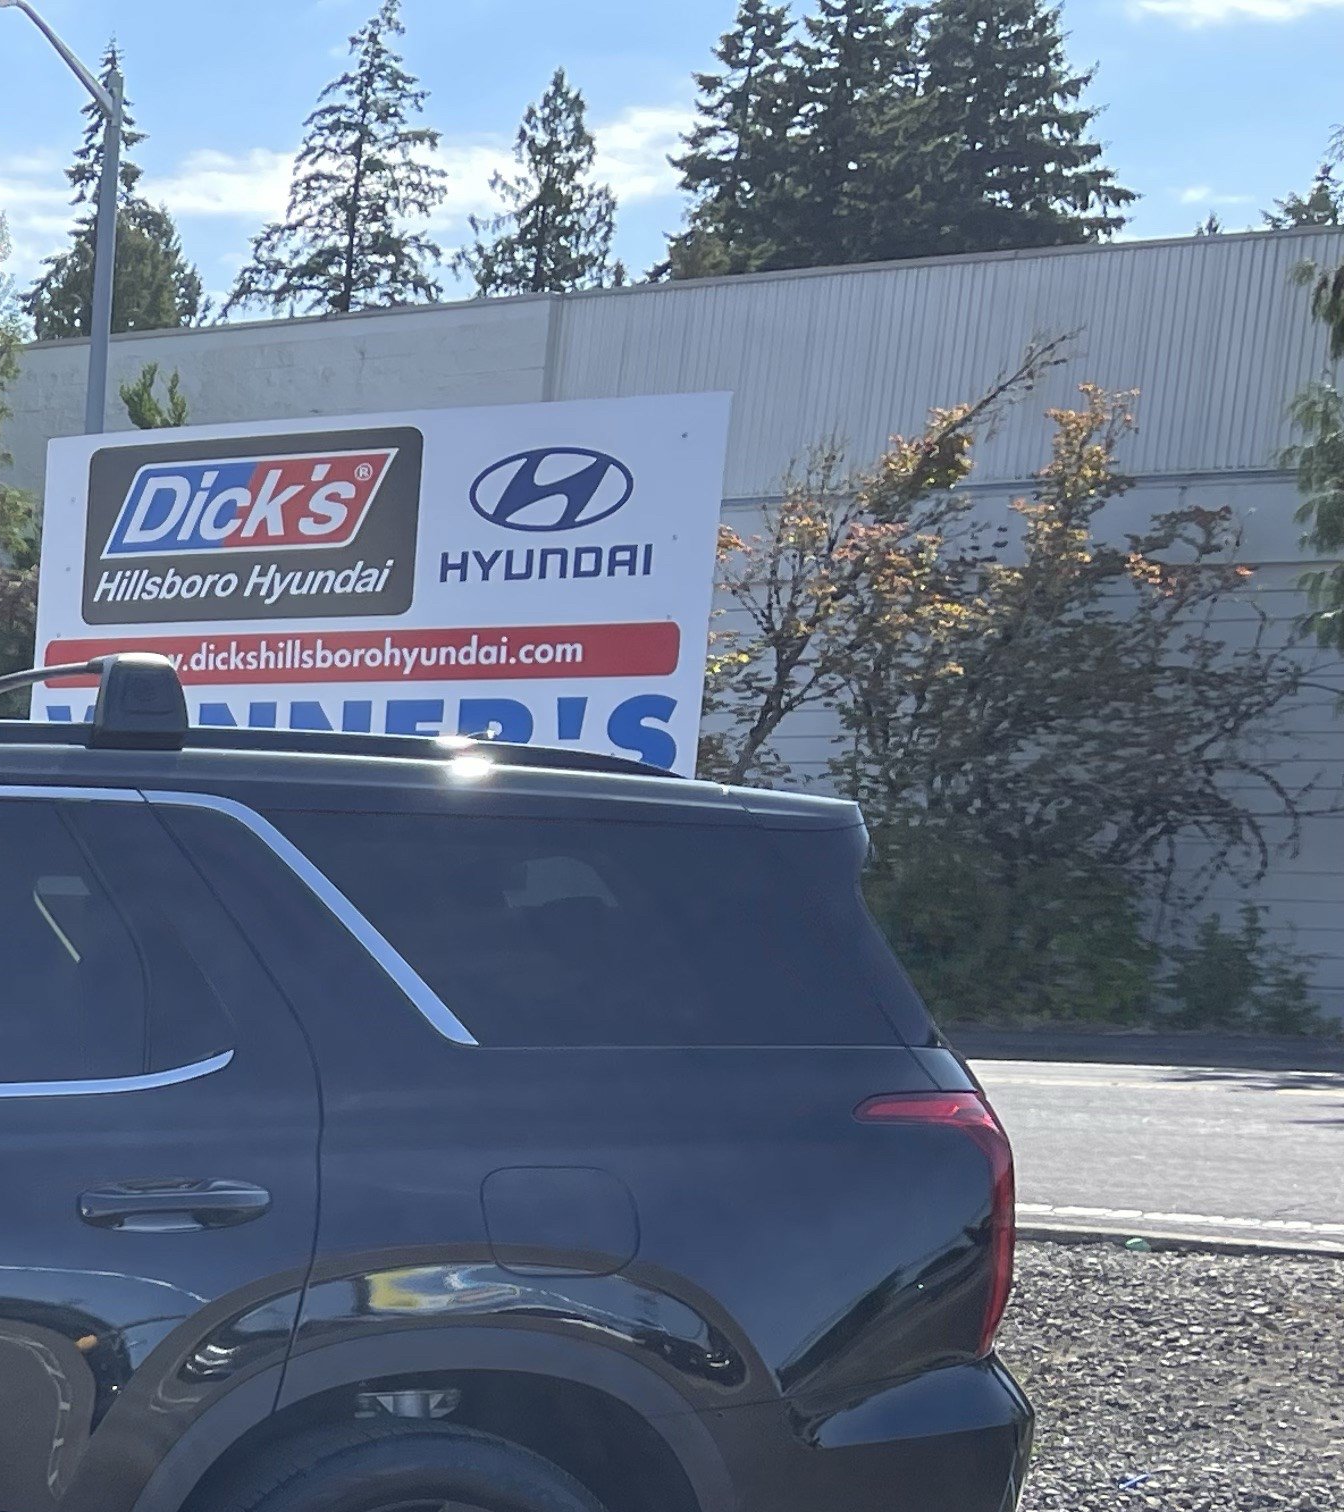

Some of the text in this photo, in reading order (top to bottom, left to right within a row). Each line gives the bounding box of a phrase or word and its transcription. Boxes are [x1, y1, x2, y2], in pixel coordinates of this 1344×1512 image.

[92, 559, 395, 605] Hillsboro Hyundai
[439, 543, 653, 583] HYUNDAI
[167, 635, 583, 675] .dickshillsborohyundai.com
